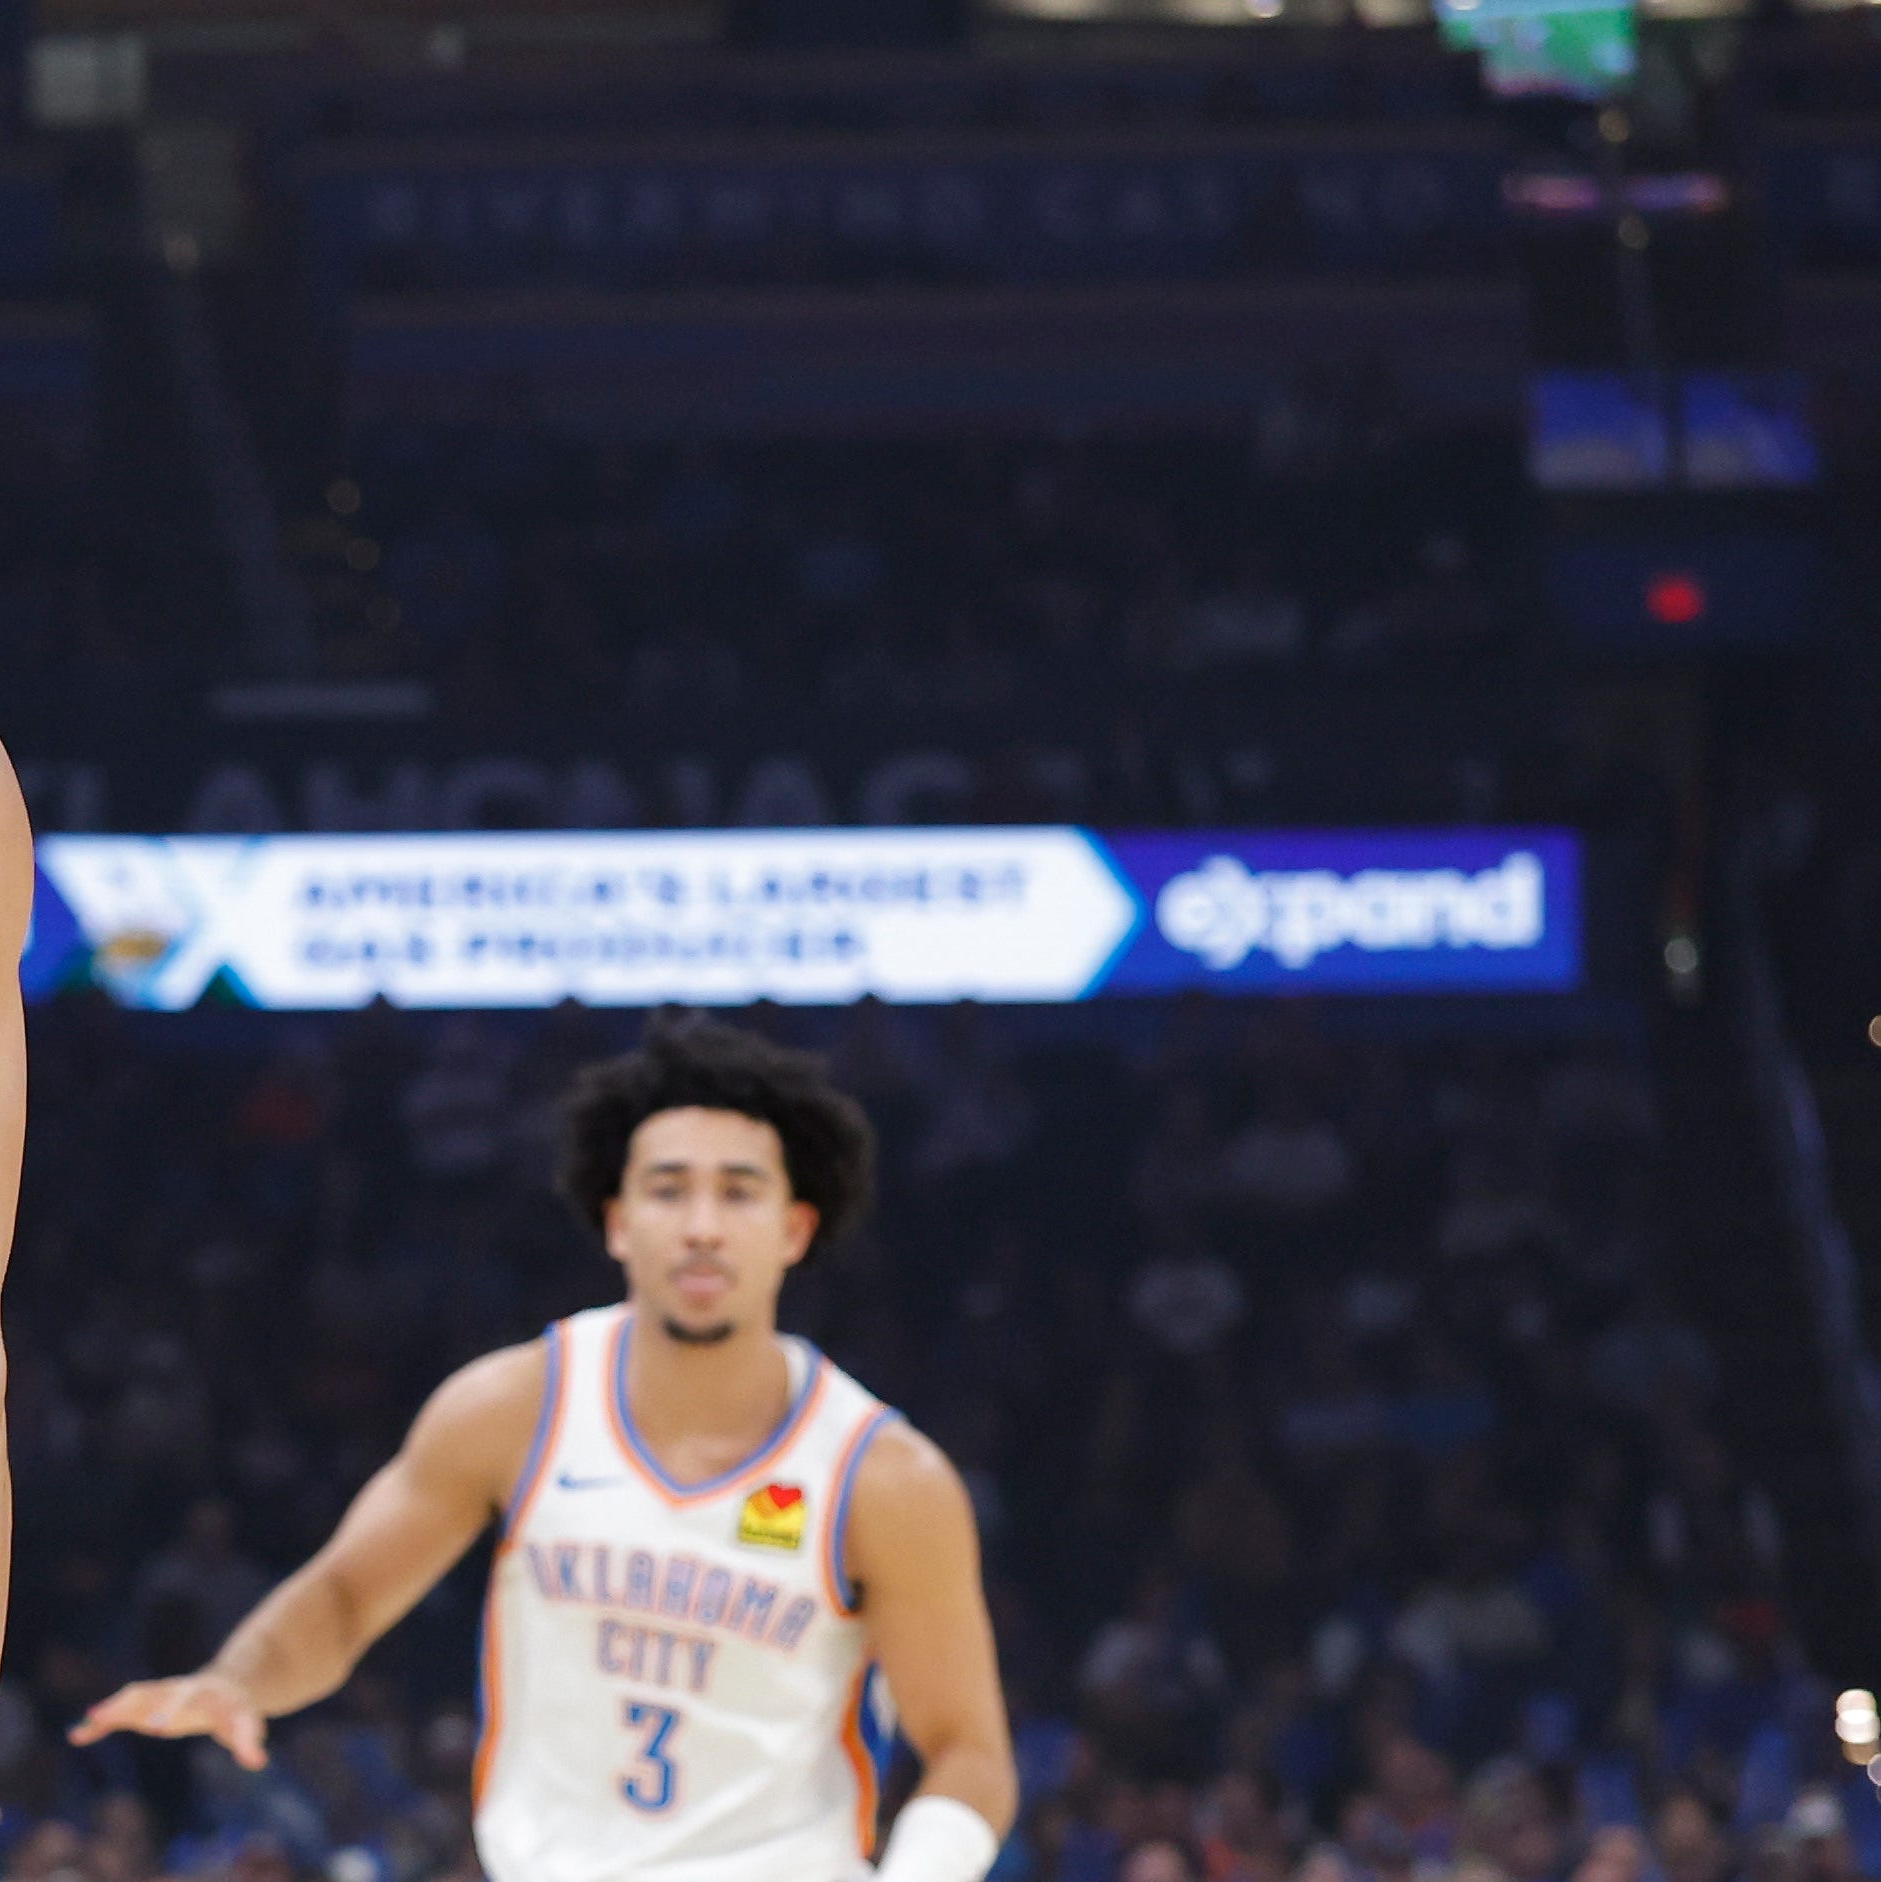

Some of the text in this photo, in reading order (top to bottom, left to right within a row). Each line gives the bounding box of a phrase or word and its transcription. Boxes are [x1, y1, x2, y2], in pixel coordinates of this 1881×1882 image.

[1155, 851, 1544, 971] expand
[522, 1541, 818, 1653] OKLAHOMA
[597, 1616, 716, 1694] CITY
[620, 1698, 682, 1817] 3
